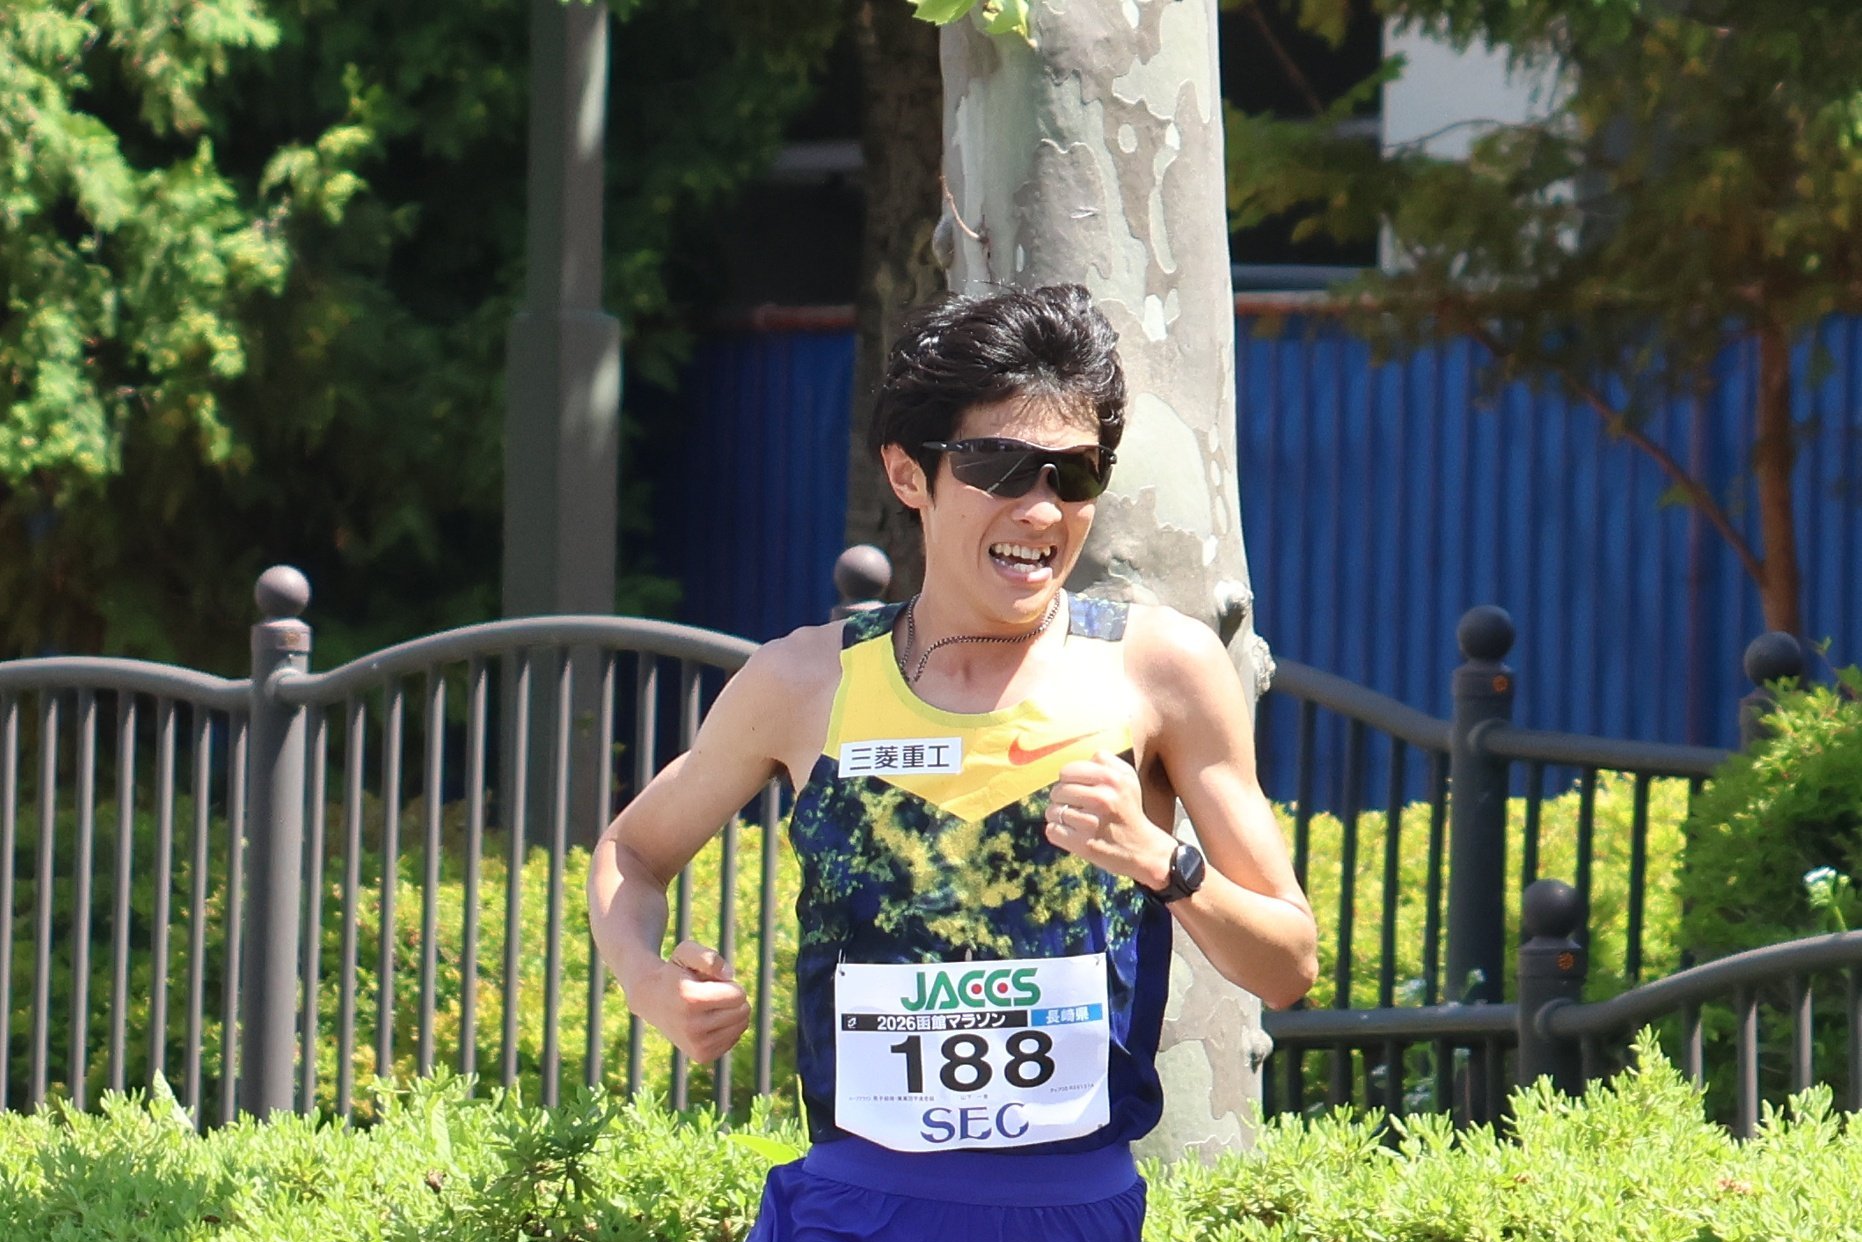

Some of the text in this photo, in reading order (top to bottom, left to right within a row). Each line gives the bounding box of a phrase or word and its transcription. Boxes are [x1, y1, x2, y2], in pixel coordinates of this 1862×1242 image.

[849, 744, 950, 771] 三菱重工
[900, 967, 1042, 1011] JACCS
[877, 1012, 1006, 1032] 2026函館マラソン
[1045, 1006, 1090, 1025] 長崎県
[890, 1030, 1056, 1094] 188
[920, 1102, 1030, 1144] SEC
